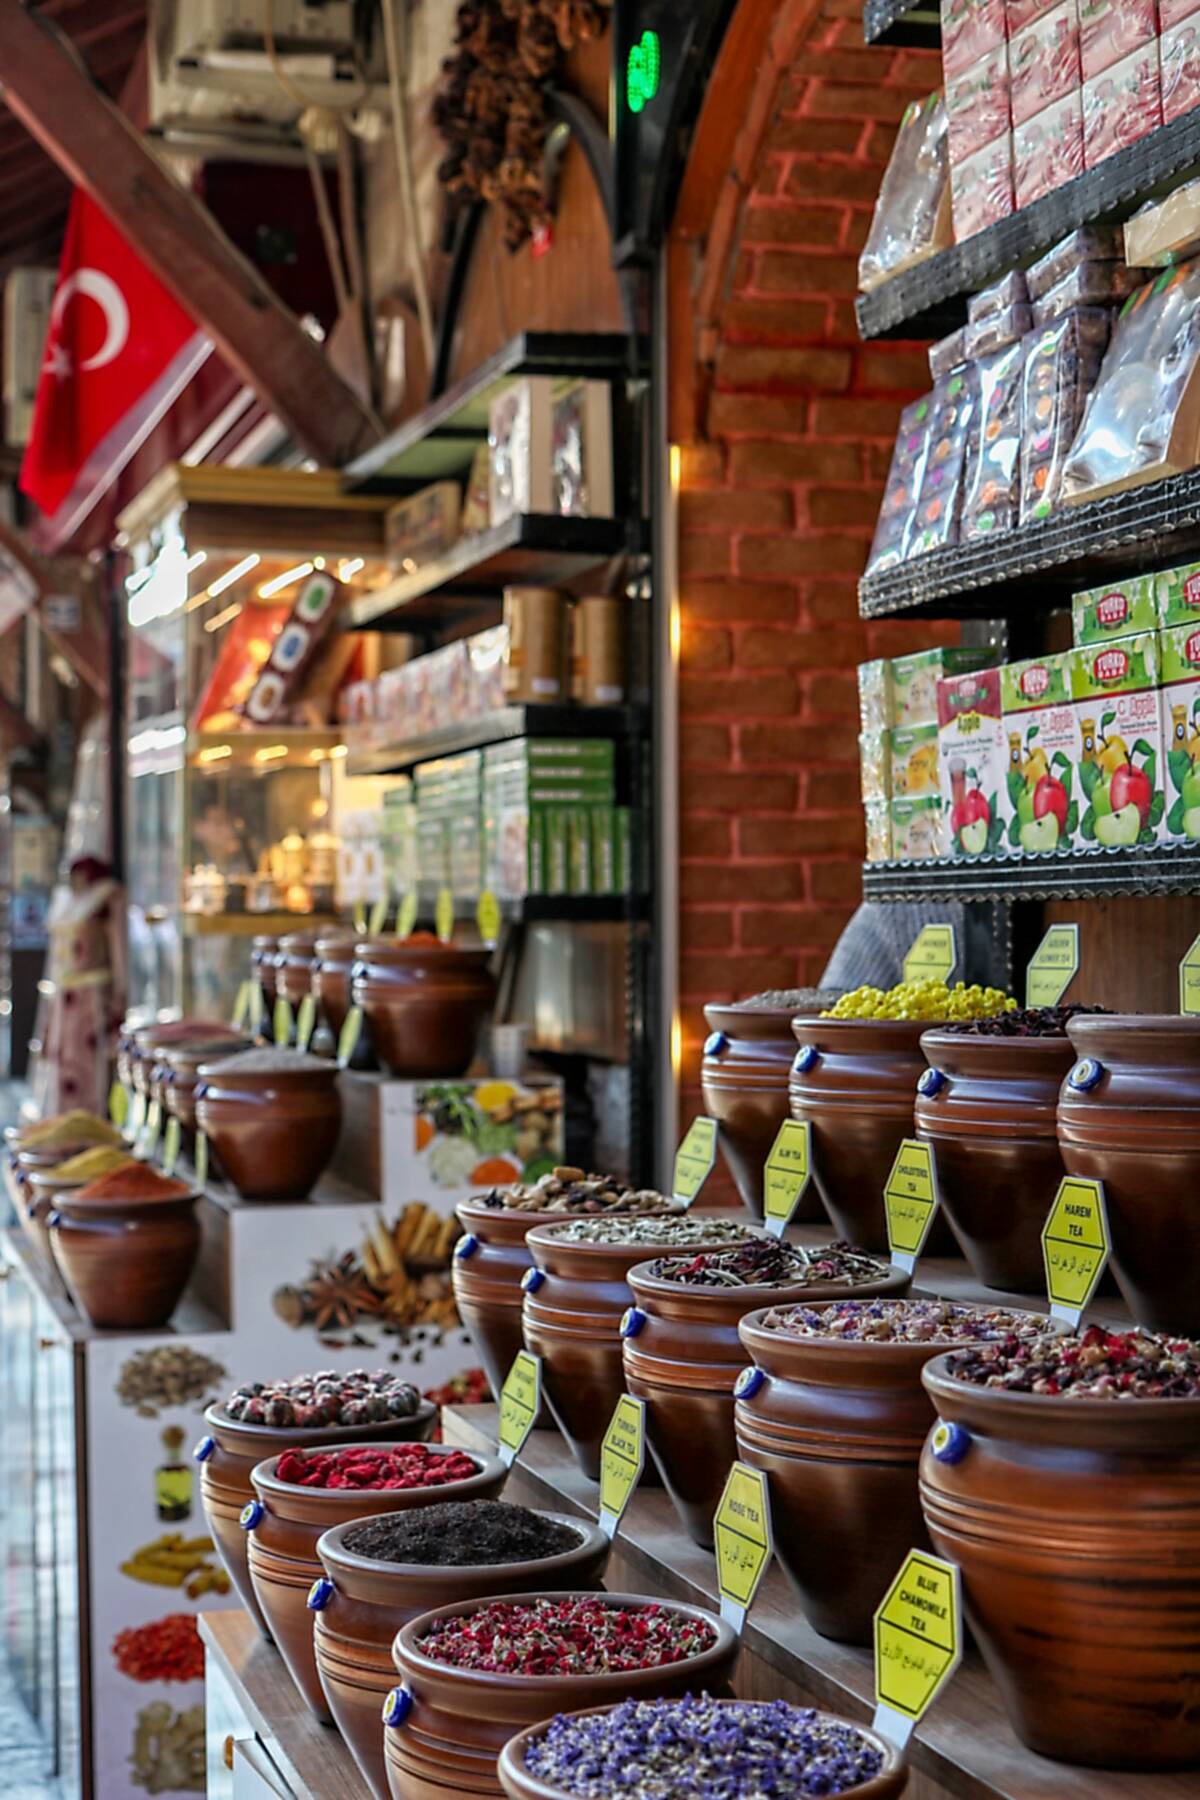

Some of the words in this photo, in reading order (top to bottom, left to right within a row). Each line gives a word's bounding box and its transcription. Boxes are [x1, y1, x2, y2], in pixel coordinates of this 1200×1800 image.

[1129, 694, 1157, 720] Apple
[1065, 1203, 1092, 1218] HAREM
[1068, 1223, 1083, 1237] TEA
[611, 1435, 626, 1450] BLACK
[626, 1441, 636, 1456] TEA
[728, 1498, 746, 1518] ROSE
[746, 1506, 760, 1524] TEA
[917, 1575, 939, 1594] BLUE
[900, 1590, 947, 1619] CHAMOMILE
[910, 1615, 927, 1633] TEA
